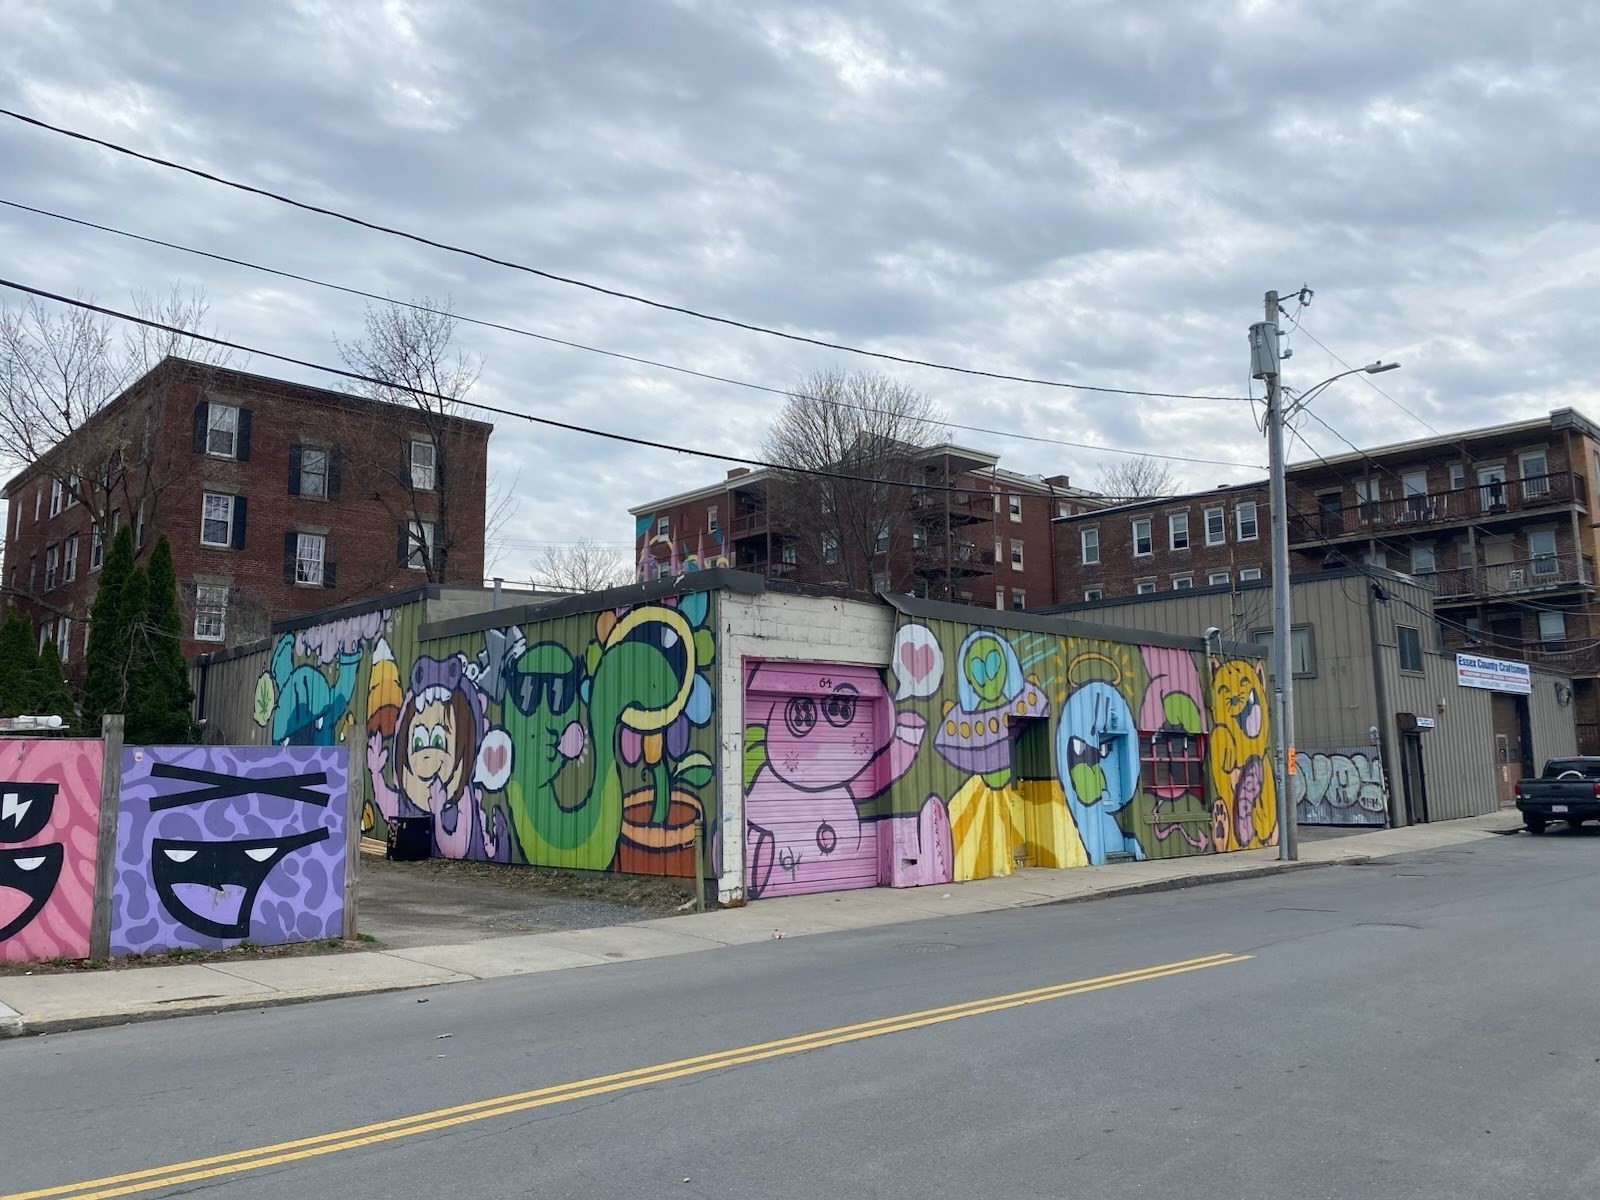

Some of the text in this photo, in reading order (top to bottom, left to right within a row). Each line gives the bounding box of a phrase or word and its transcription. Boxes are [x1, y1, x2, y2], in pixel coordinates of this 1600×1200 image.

[1459, 656, 1528, 675] Essex County Craftsmen
[819, 677, 832, 688] 64
